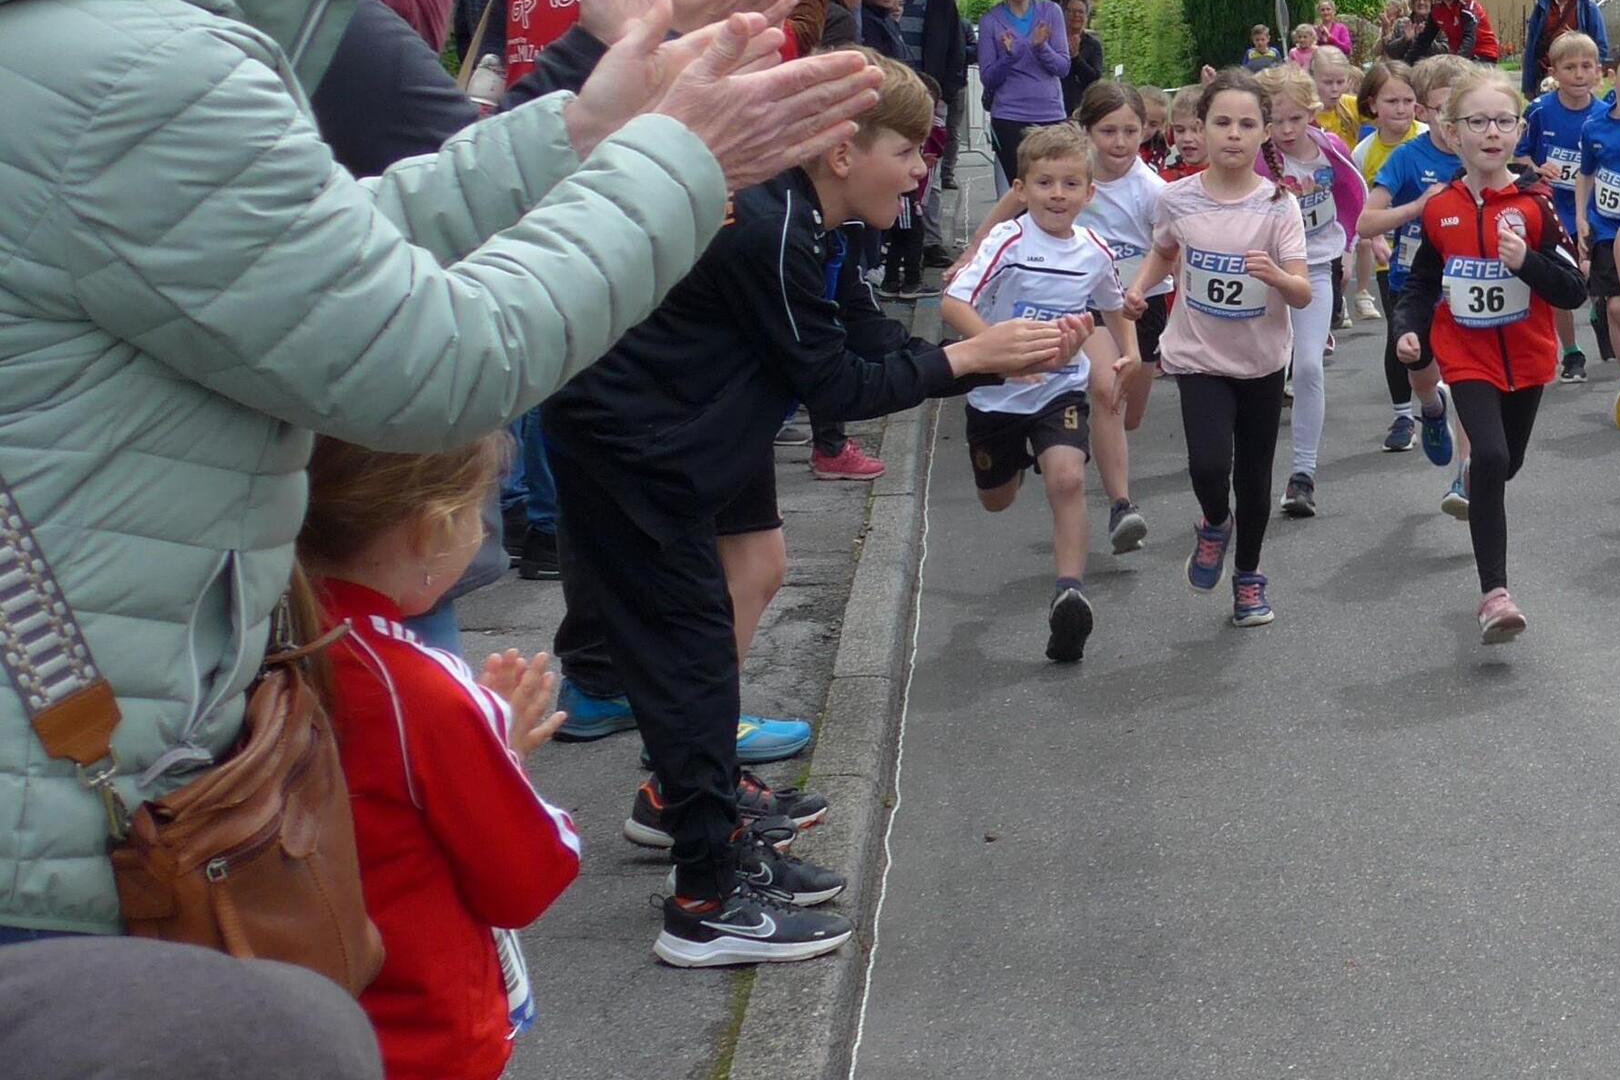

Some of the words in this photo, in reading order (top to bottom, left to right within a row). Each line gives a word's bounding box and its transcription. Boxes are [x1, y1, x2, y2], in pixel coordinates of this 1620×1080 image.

[1551, 147, 1582, 162] PETE
[1600, 187, 1620, 209] 55
[1190, 250, 1247, 274] PETE
[1450, 258, 1513, 279] PETER
[1207, 278, 1243, 306] 62
[1468, 286, 1505, 313] 36
